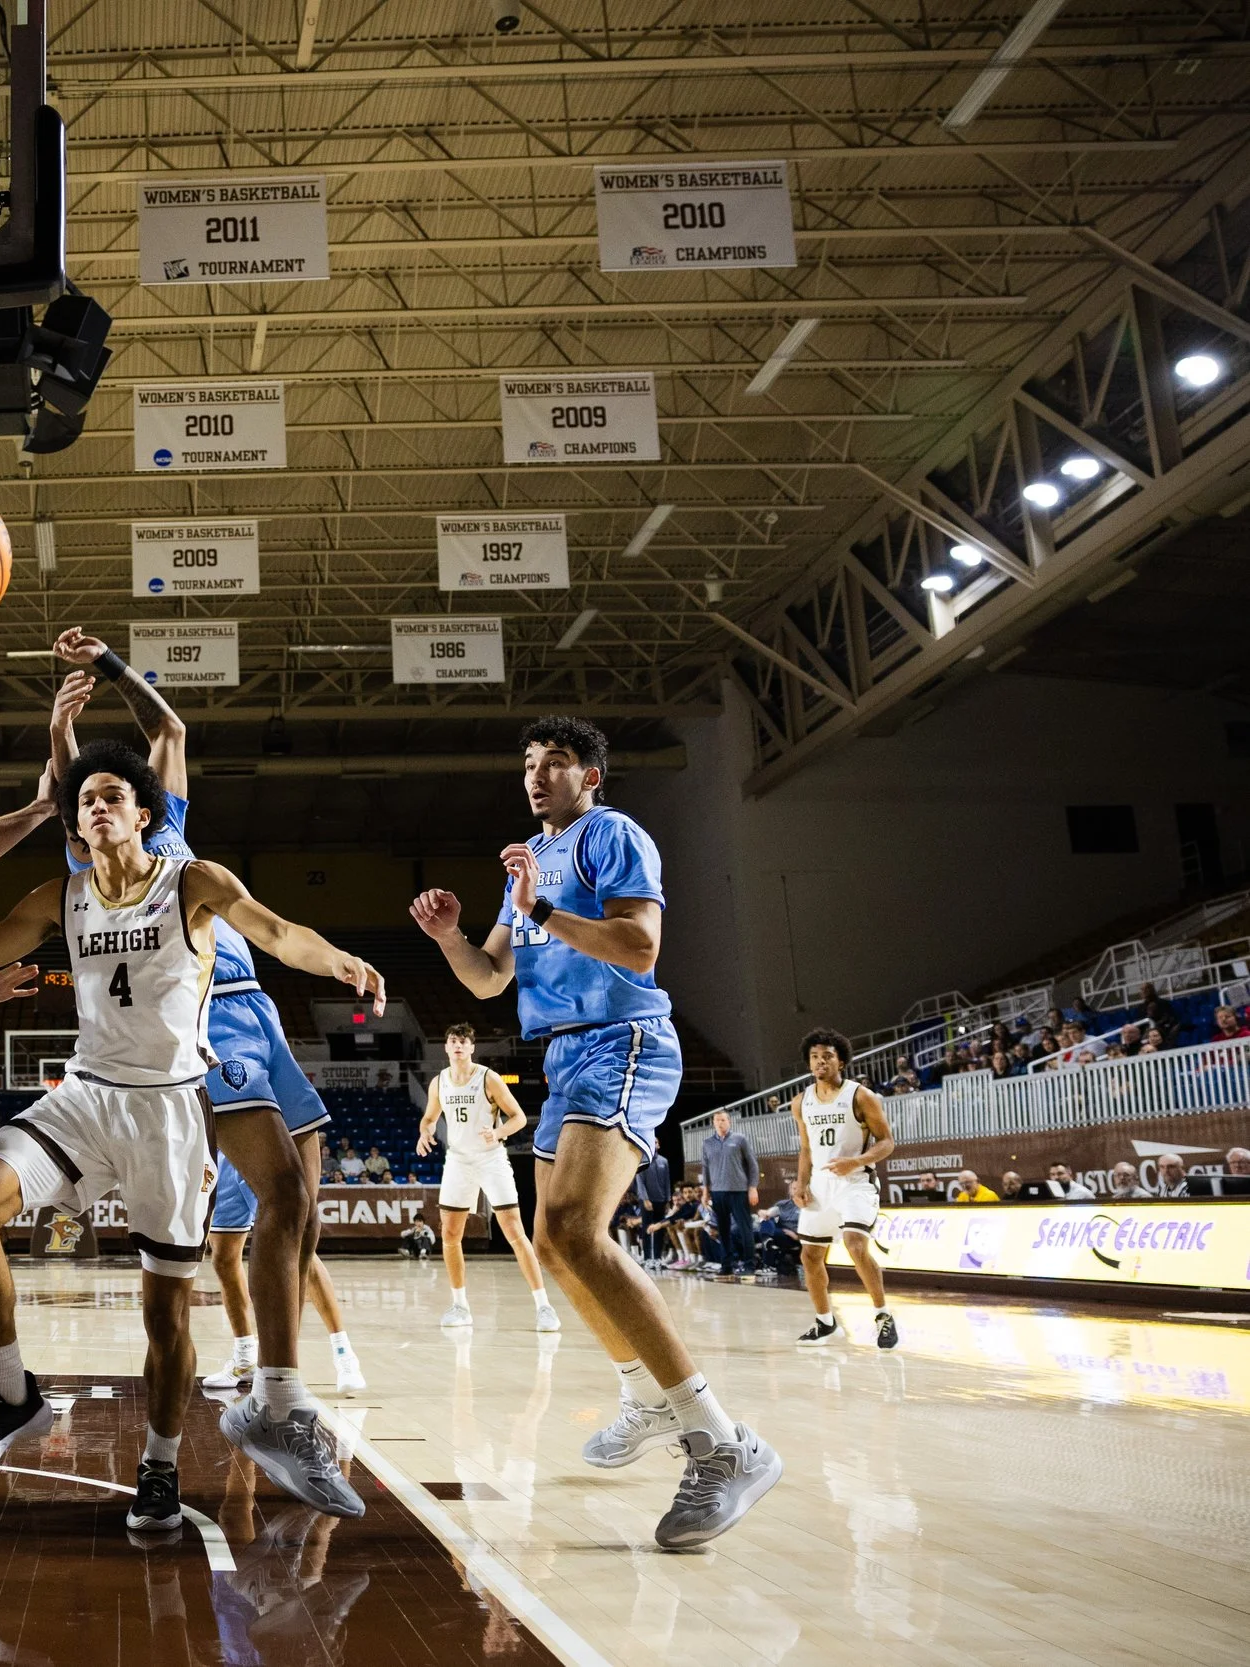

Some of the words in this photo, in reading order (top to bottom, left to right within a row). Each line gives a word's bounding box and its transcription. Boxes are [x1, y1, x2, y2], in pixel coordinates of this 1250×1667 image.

[600, 174, 674, 189] WOMEN'S
[678, 171, 782, 186] BASKETBALL
[144, 189, 215, 205] WOMEN'S
[220, 185, 320, 201] BASKETBALL
[662, 202, 726, 229] 2010
[206, 216, 260, 243] 2011
[676, 245, 767, 261] CHAMPIONS
[199, 258, 305, 276] TOURNAMENT
[505, 383, 563, 394] WOMEN'S
[567, 380, 650, 394] BASKETBALL
[138, 392, 195, 404] WOMEN'S
[199, 389, 280, 403] BASKETBALL
[552, 406, 607, 428] 2009
[185, 414, 233, 437] 2010
[182, 450, 267, 463] TOURNAMENT
[564, 442, 637, 455] CHAMPIONS
[135, 529, 184, 539] WOMEN'S
[187, 527, 254, 538] BASKETBALL
[440, 522, 490, 532] WOMEN'S
[493, 520, 562, 532] BASKETBALL
[173, 548, 218, 568] 2009
[482, 542, 523, 562] 1997
[172, 578, 244, 590] TOURNAMENT
[490, 573, 550, 584] CHAMPIONS
[133, 628, 175, 637] WOMEN'S
[177, 627, 235, 637] BASKETBALL
[394, 624, 437, 633] WOMEN'S
[439, 623, 499, 633] BASKETBALL
[167, 646, 201, 662] 1997
[430, 642, 466, 659] 1986
[164, 672, 226, 682] TOURNAMENT
[436, 668, 488, 678] CHAMPIONS
[77, 926, 161, 958] LEHIGH
[45, 973, 74, 986] 19:3
[108, 963, 133, 1007] 4
[322, 1067, 369, 1078] STUDENT
[325, 1078, 366, 1089] SECTION
[445, 1095, 475, 1104] LEHIGH
[455, 1107, 468, 1122] 15
[808, 1113, 846, 1125] LEHIGH
[819, 1128, 836, 1146] 10
[887, 1158, 918, 1172] LEHIGH
[918, 1154, 963, 1169] UNIVERSITY
[317, 1200, 424, 1224] GIANT
[888, 1216, 946, 1241] ELECTRIC
[1032, 1218, 1111, 1249] SERVICE
[1114, 1217, 1214, 1250] ELECTRIC
